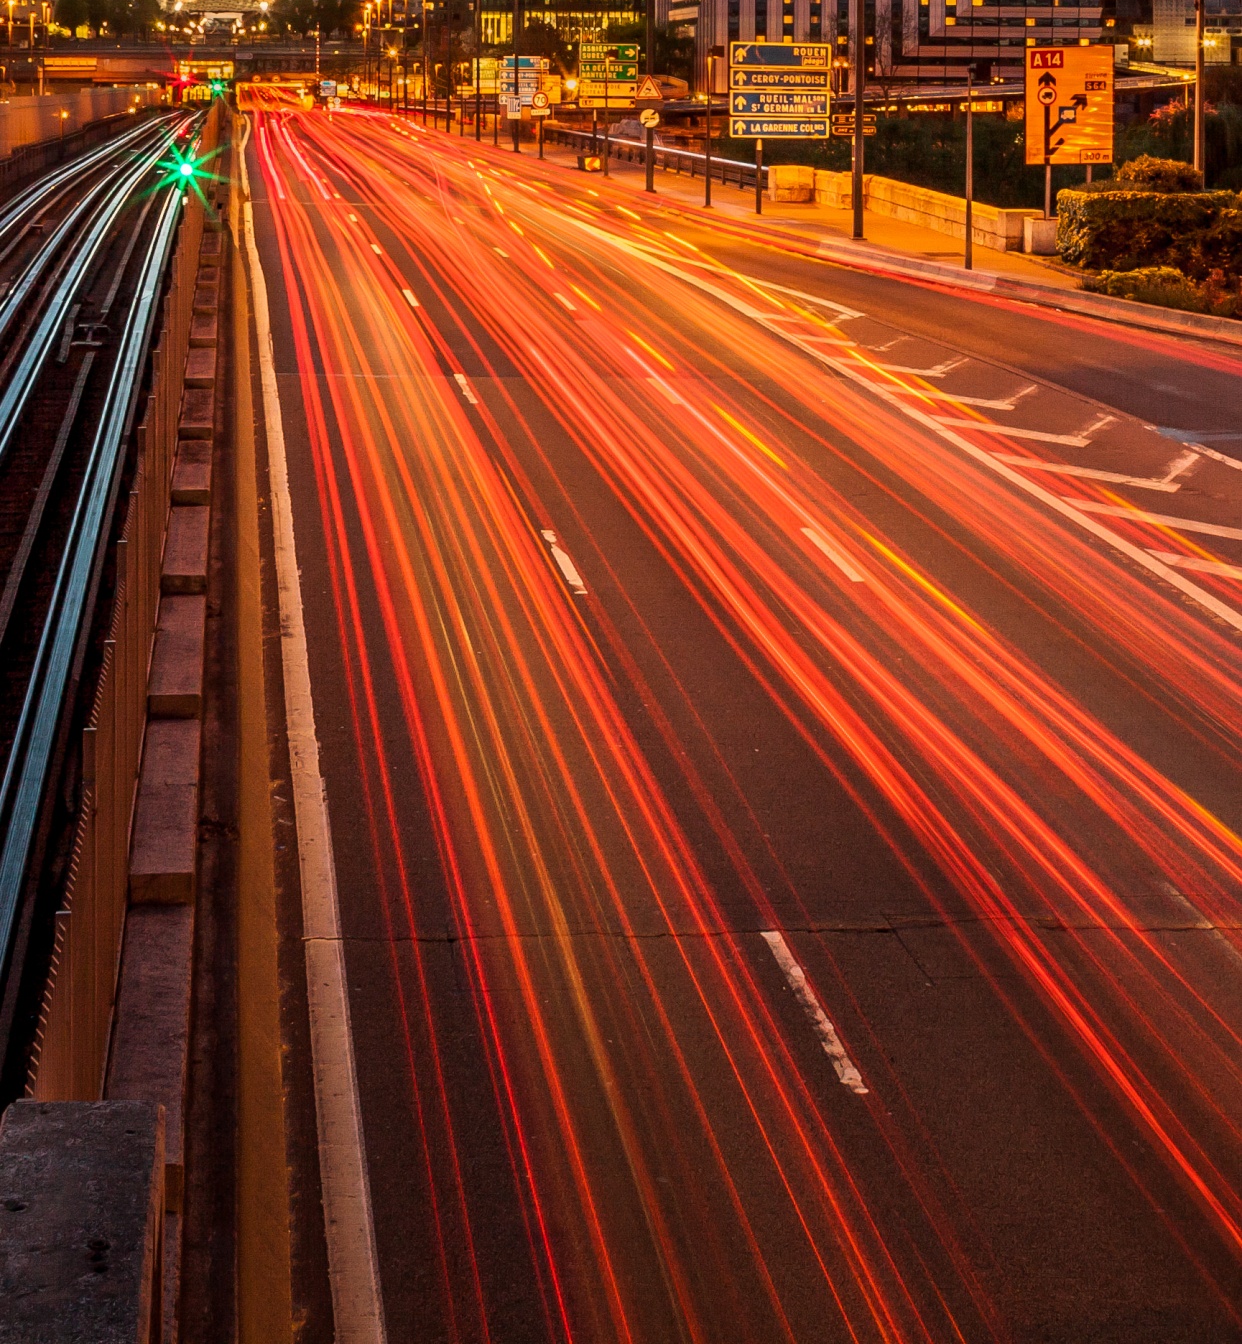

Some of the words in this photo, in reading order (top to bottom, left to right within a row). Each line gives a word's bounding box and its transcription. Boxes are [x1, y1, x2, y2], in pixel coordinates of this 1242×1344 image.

[793, 47, 826, 56] ROUEN
[592, 64, 623, 72] DÉFNSE
[751, 74, 825, 84] CERGY-PONTOISE
[536, 96, 546, 104] 70
[763, 104, 804, 113] GERMAIN
[750, 123, 760, 132] LA
[762, 123, 798, 132] GARENNE
